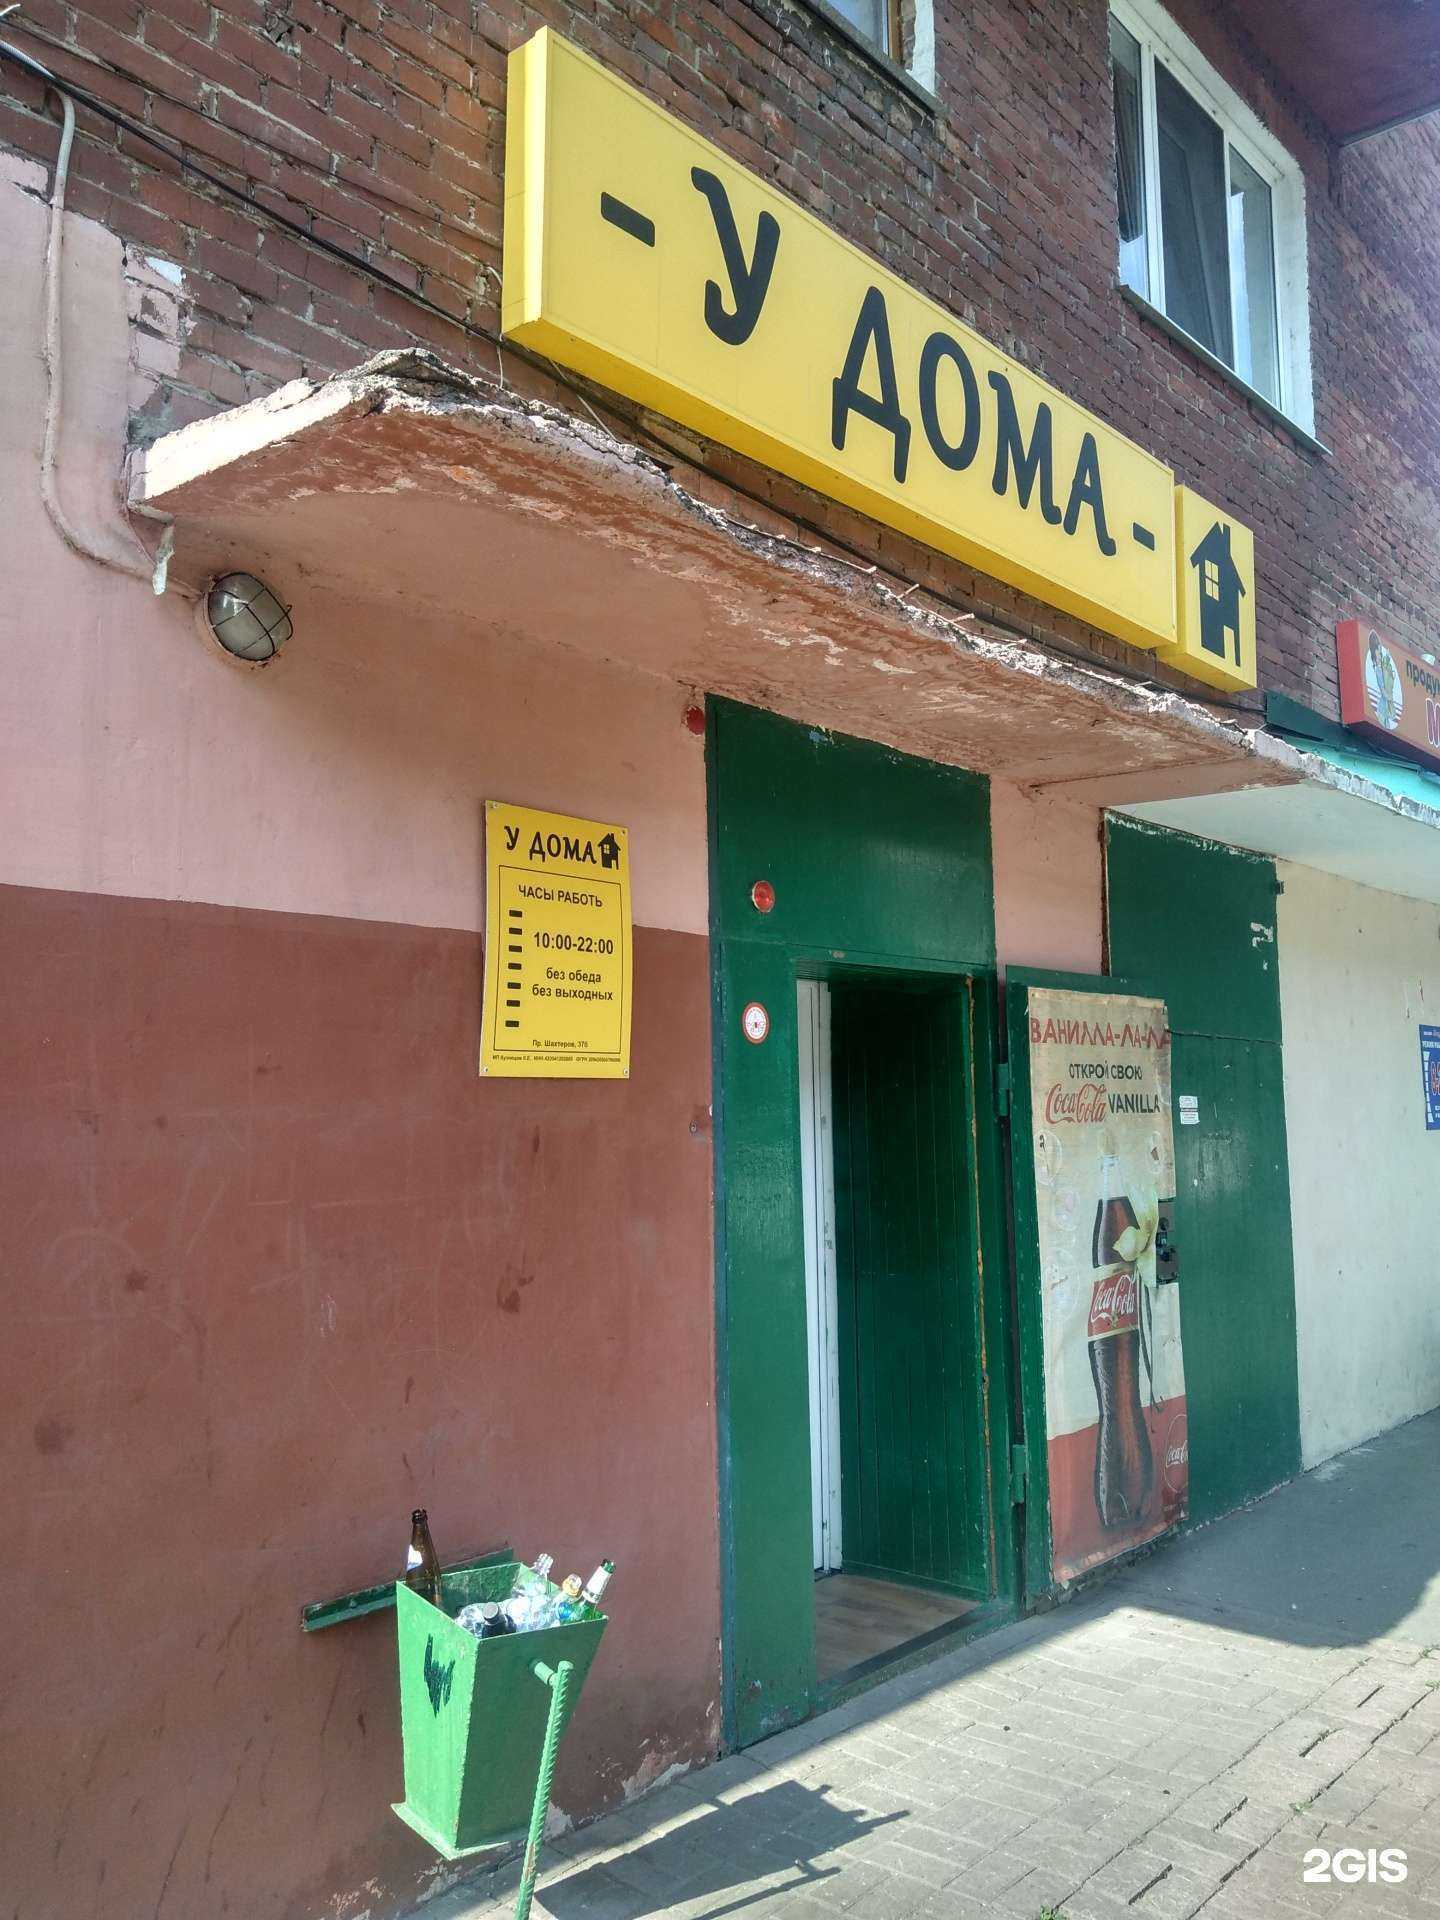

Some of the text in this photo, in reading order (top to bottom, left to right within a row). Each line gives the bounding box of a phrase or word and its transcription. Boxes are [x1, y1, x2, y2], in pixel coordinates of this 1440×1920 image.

[691, 167, 1116, 556] У ДОМА
[504, 825, 598, 864] У ДОМА
[518, 884, 554, 901] ЧАСЫ
[533, 931, 614, 955] 10:00-22:00
[546, 967, 602, 984] без обеда
[532, 983, 613, 1001] без выходных
[1069, 1061, 1142, 1081] ОТКРОЙ СВОЮ
[1108, 1094, 1160, 1114] VANILLA
